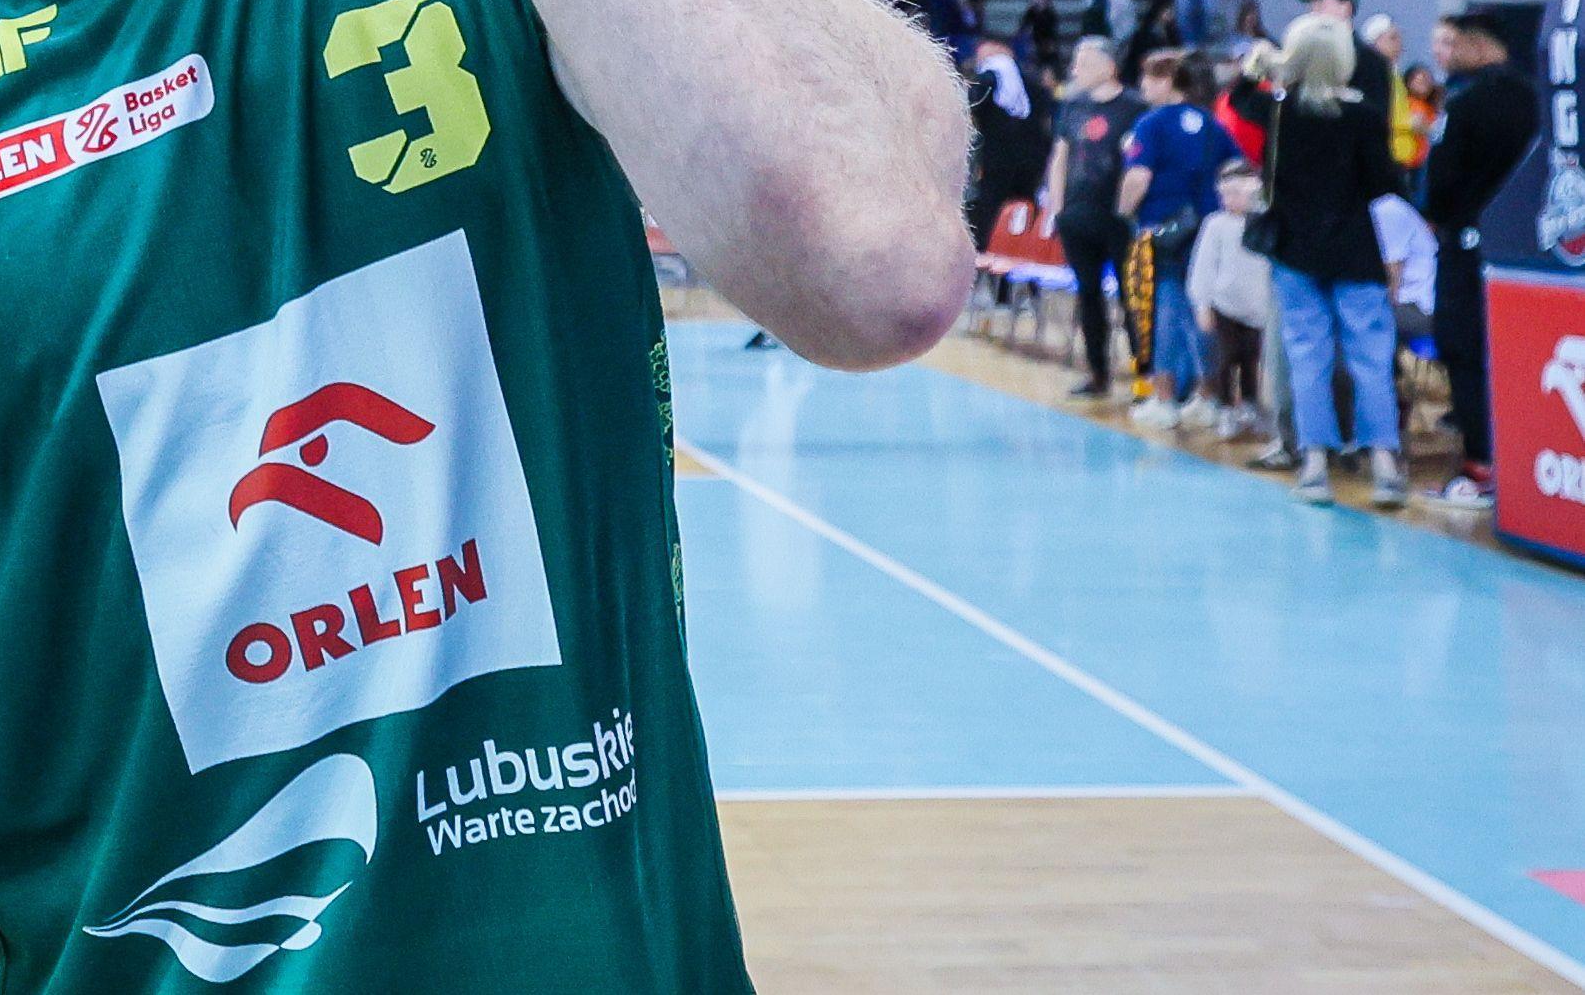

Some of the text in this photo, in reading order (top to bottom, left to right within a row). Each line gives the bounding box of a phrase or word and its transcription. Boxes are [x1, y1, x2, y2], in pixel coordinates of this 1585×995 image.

[125, 65, 199, 112] Basket
[129, 100, 177, 137] Liga
[226, 539, 488, 684] ORLEN
[417, 707, 635, 823] Lubuskie
[427, 806, 536, 856] Warte
